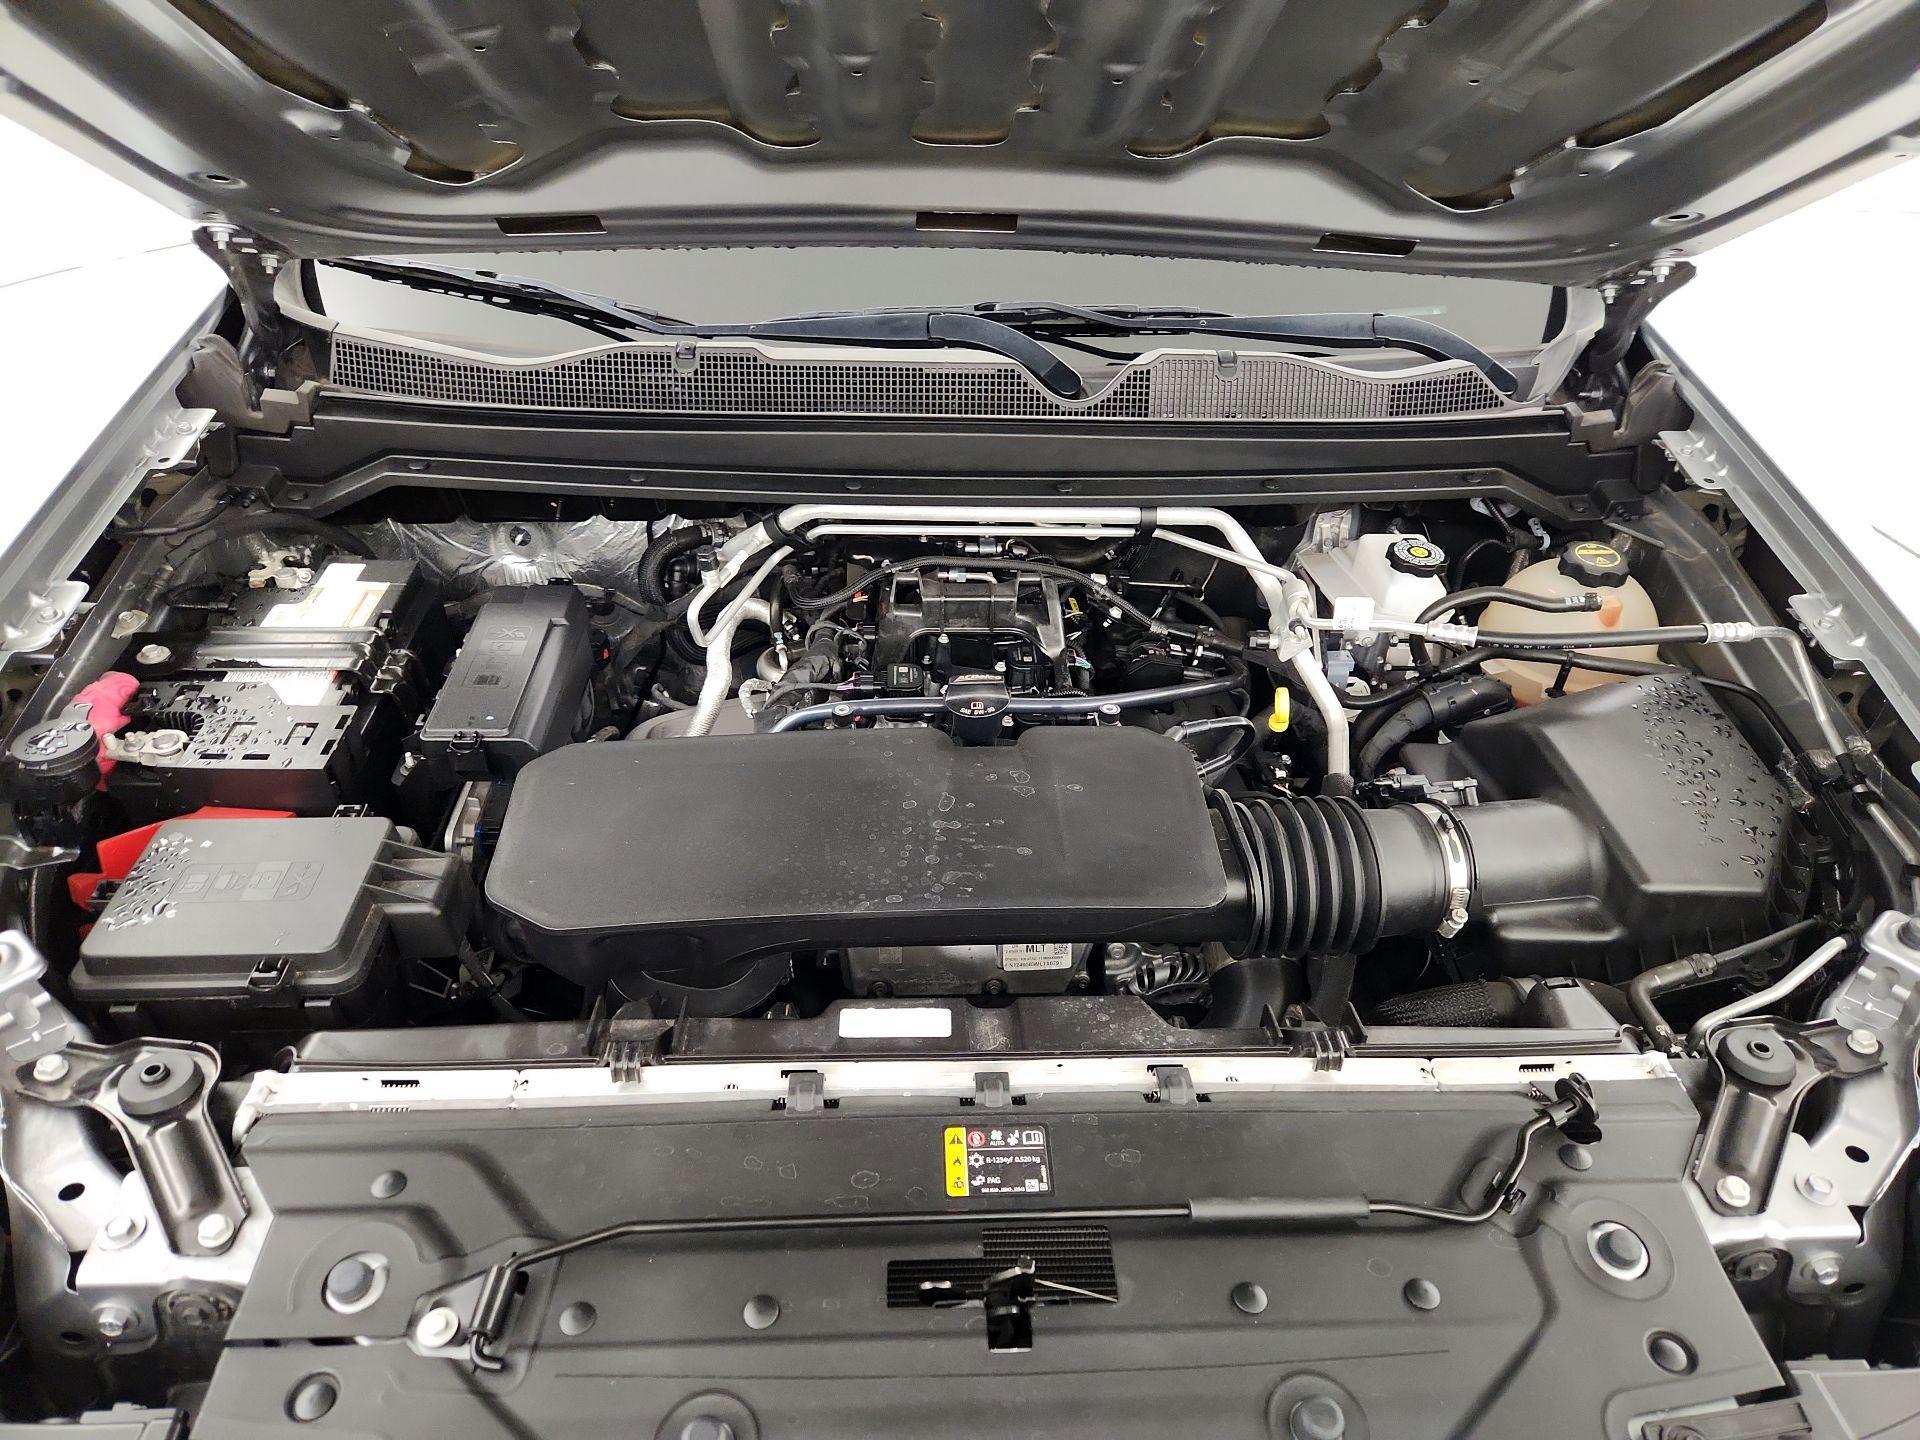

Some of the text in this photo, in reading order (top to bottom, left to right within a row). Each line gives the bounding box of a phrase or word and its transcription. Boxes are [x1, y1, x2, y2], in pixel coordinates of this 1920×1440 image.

[953, 674, 1002, 683] ACDelco
[1025, 944, 1046, 953] MLT
[986, 1156, 1014, 1165] R-1234yf
[1032, 1155, 1041, 1164] kg
[986, 1176, 1001, 1184] PAG
